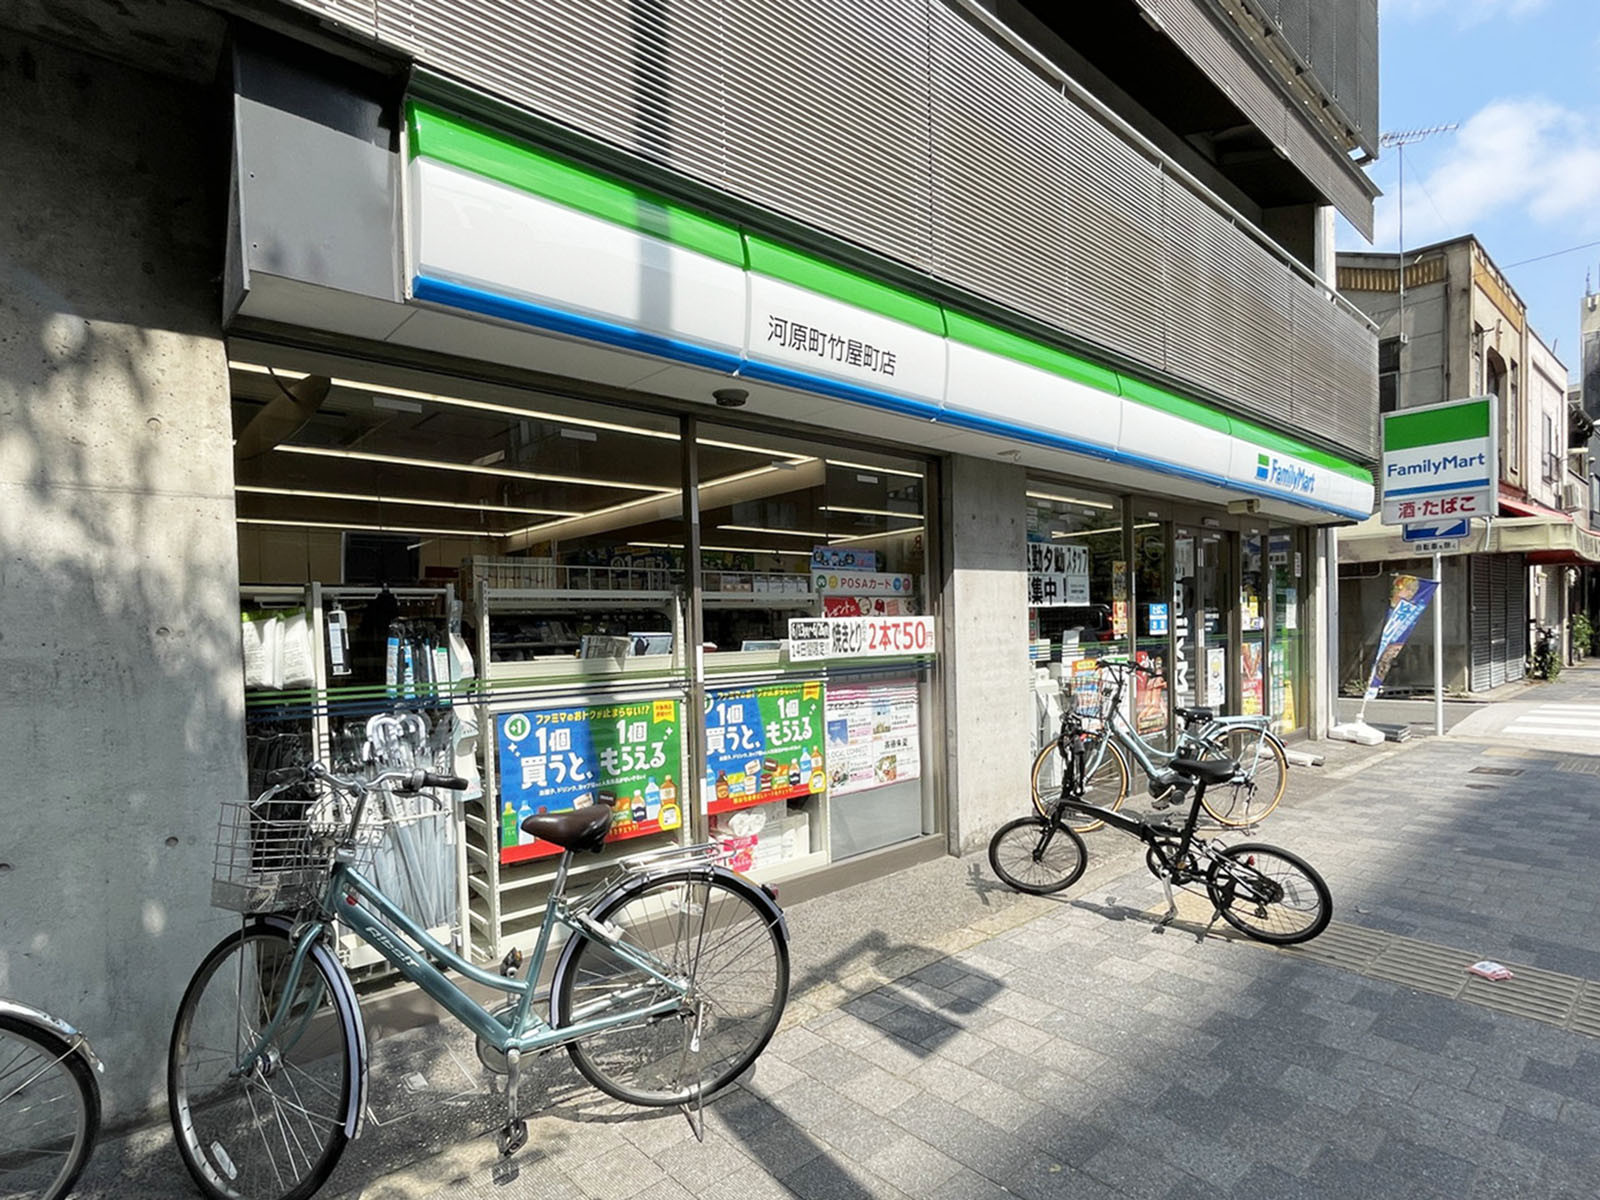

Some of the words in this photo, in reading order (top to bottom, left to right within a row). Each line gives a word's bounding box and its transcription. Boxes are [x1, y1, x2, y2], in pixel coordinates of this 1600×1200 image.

[767, 314, 896, 376] 河原町竹屋町店
[1271, 458, 1315, 494] FamilyMart
[1387, 453, 1485, 477] FamilyMart
[1398, 496, 1476, 518] 酒・たばこ
[716, 703, 743, 726] 1個
[777, 697, 799, 719] 1個
[535, 727, 571, 754] 1個
[616, 719, 647, 745] 1個
[766, 716, 813, 746] もらえる
[521, 752, 593, 790] 買うと、
[600, 742, 666, 776] もらえる
